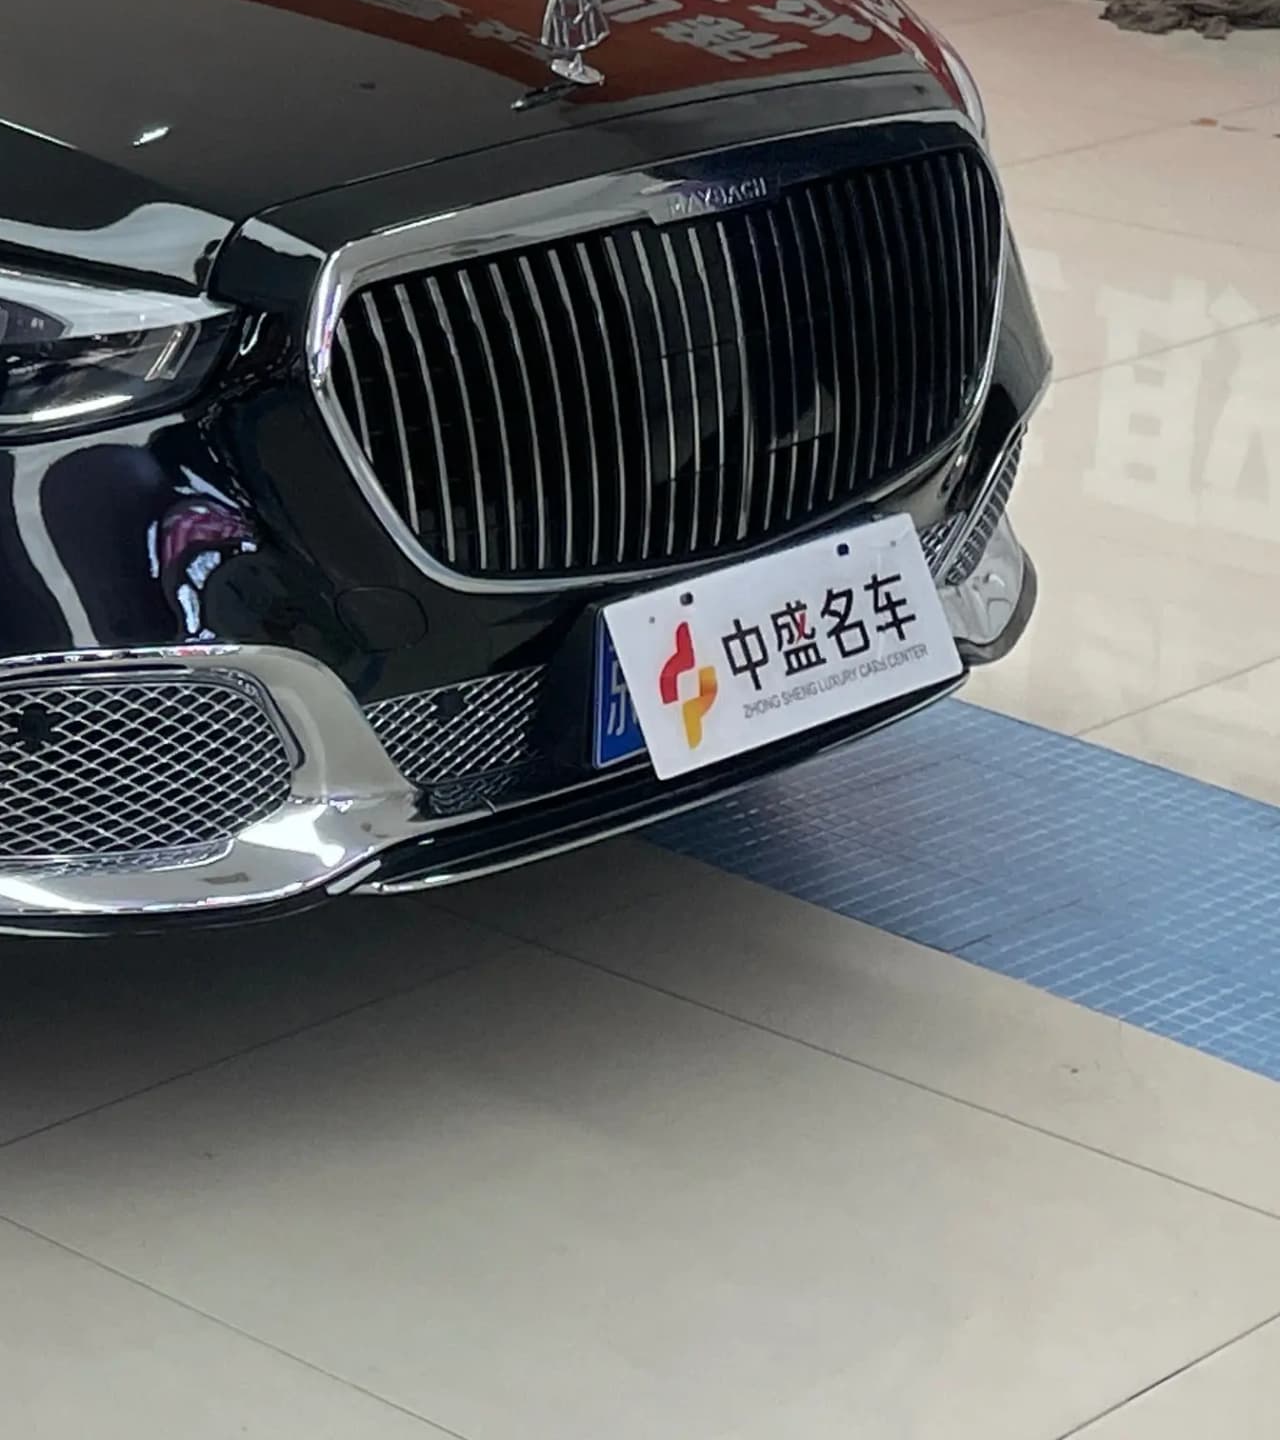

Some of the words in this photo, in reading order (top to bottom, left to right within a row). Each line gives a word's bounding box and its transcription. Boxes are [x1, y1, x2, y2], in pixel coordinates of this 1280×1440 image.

[669, 176, 768, 215] MAYBACH
[721, 573, 916, 691] 中盛名车
[781, 681, 819, 705] SHENG
[818, 669, 859, 692] LUXURY
[886, 643, 929, 669] CENTER
